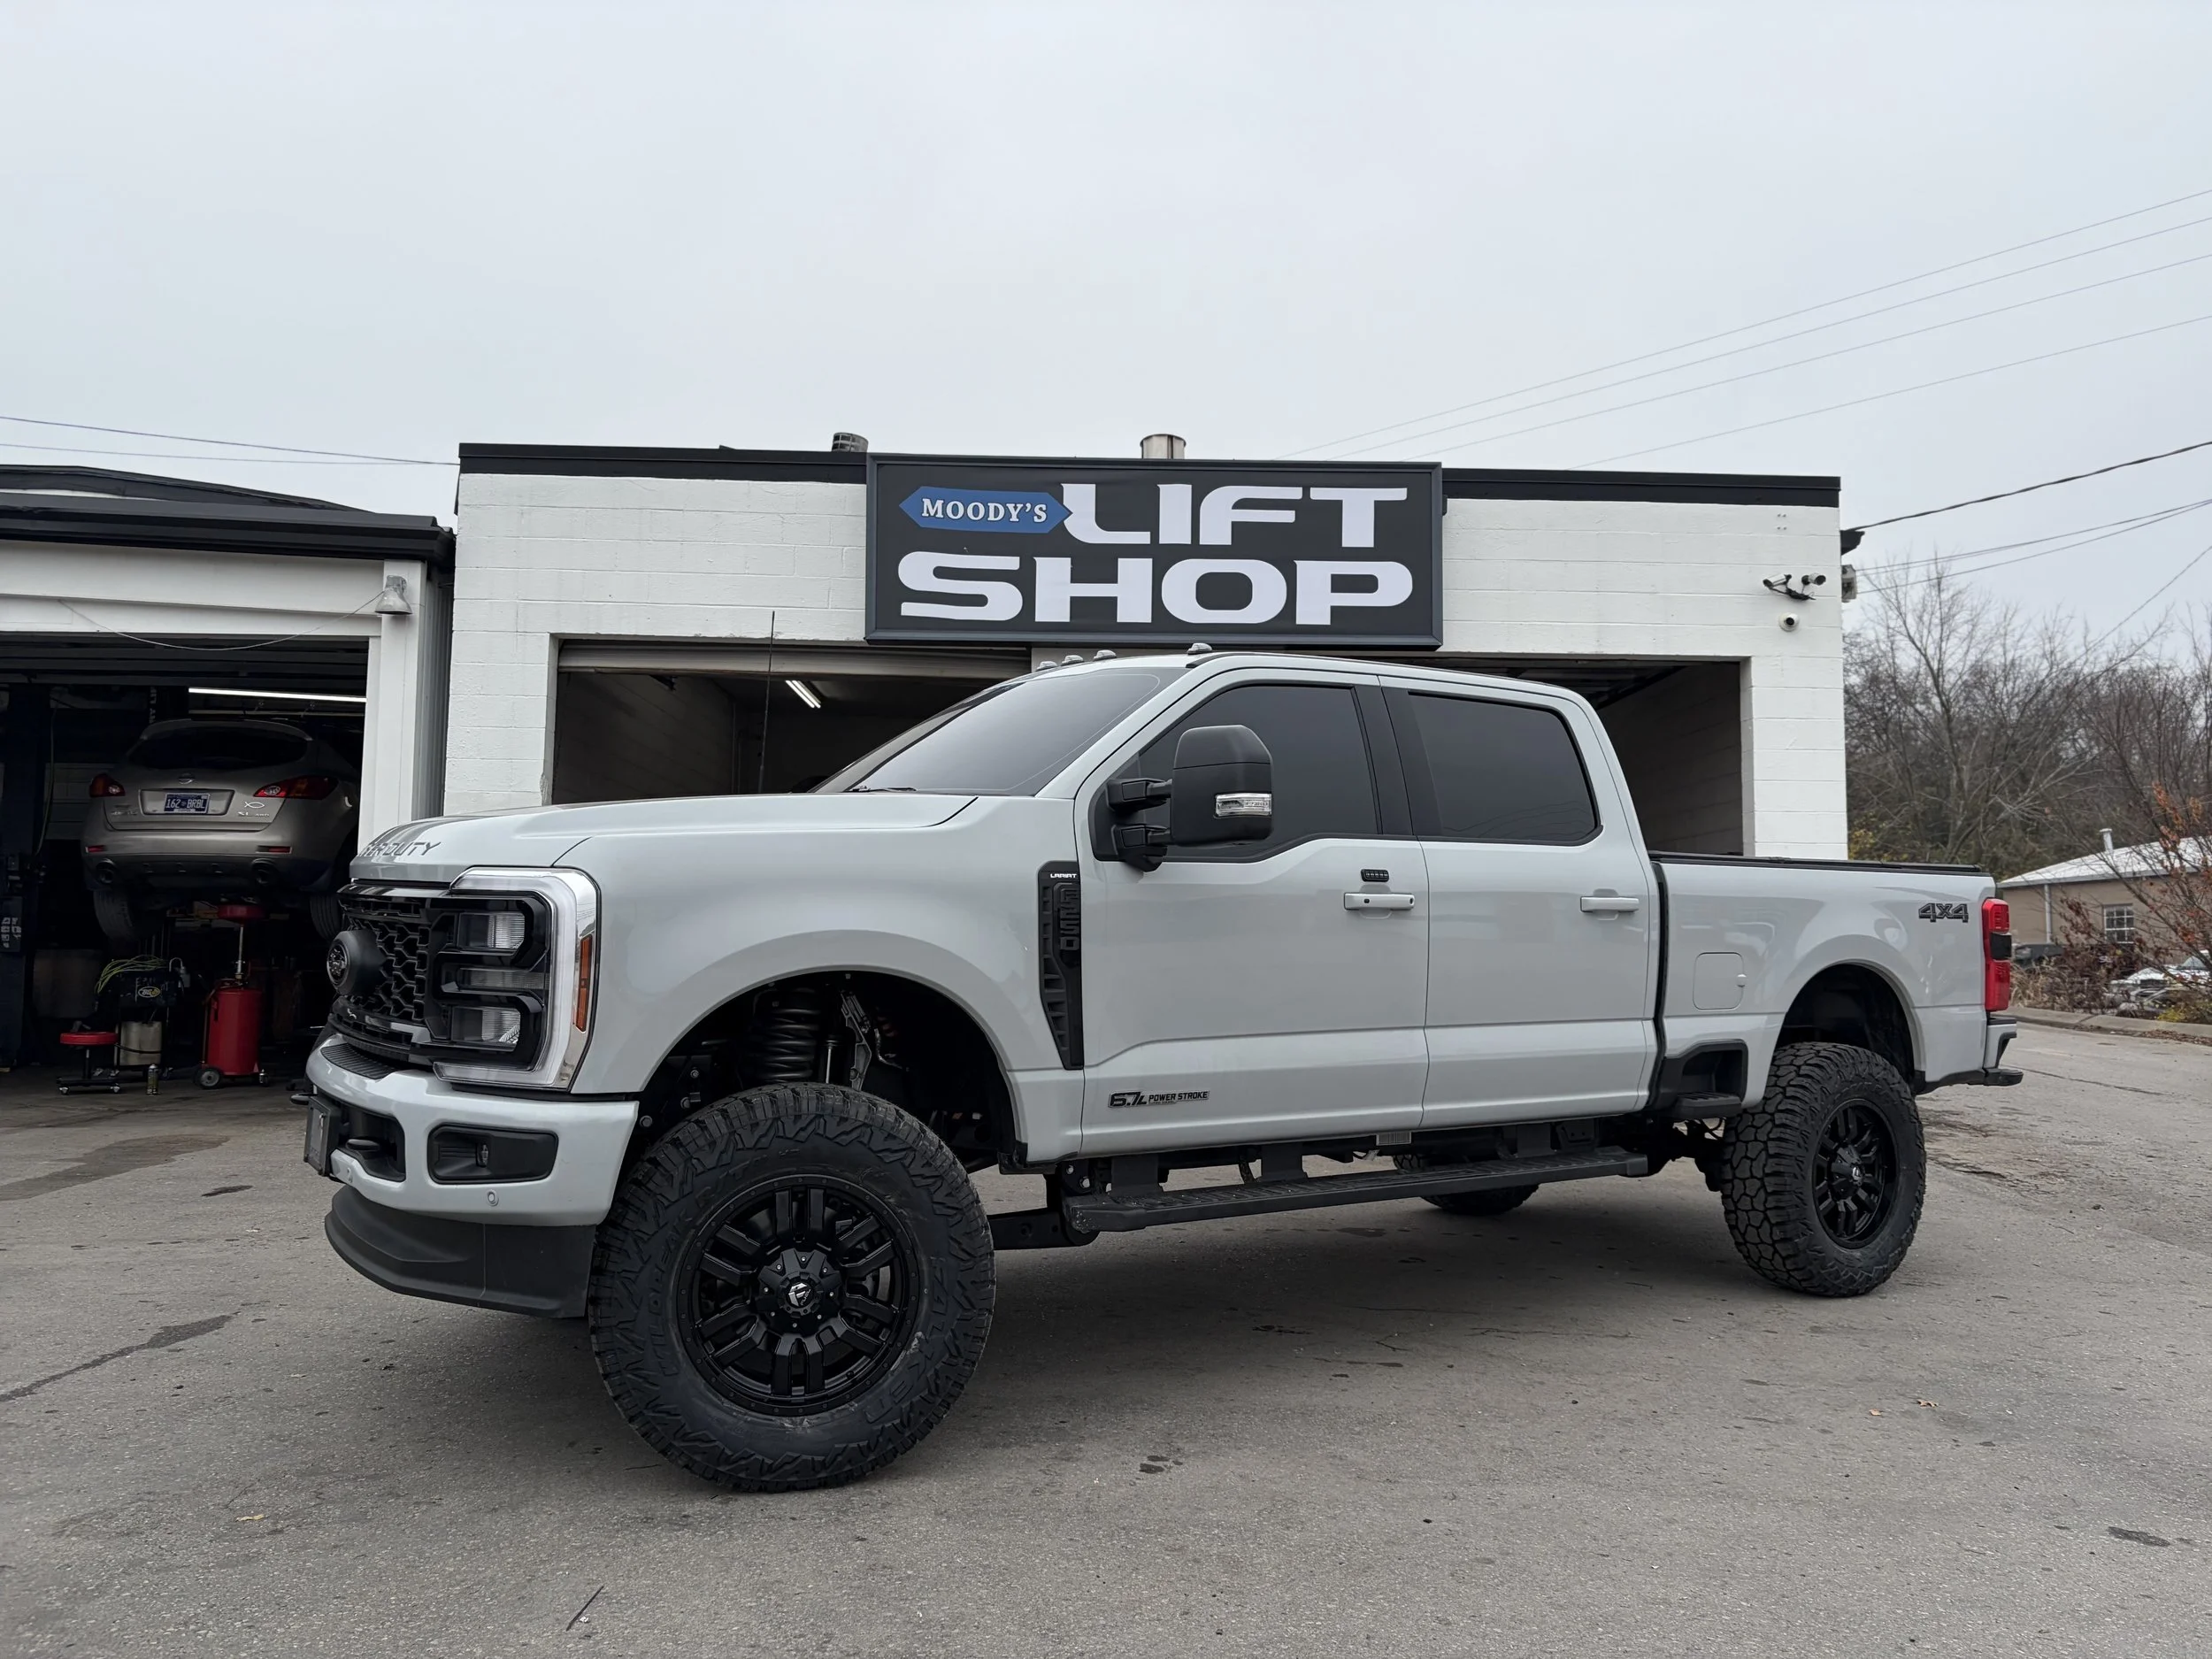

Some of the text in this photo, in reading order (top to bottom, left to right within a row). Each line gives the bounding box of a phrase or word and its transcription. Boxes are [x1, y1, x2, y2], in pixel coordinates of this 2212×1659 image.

[921, 497, 1048, 523] MOODY'S
[1061, 483, 1409, 548] LIFT
[898, 550, 1413, 626] SHOP
[165, 798, 205, 809] 162 BRBL
[381, 841, 442, 856] DUTY
[1110, 1091, 1148, 1107] 6.7L
[1148, 1093, 1177, 1102] POWER
[1177, 1090, 1209, 1101] STROKE
